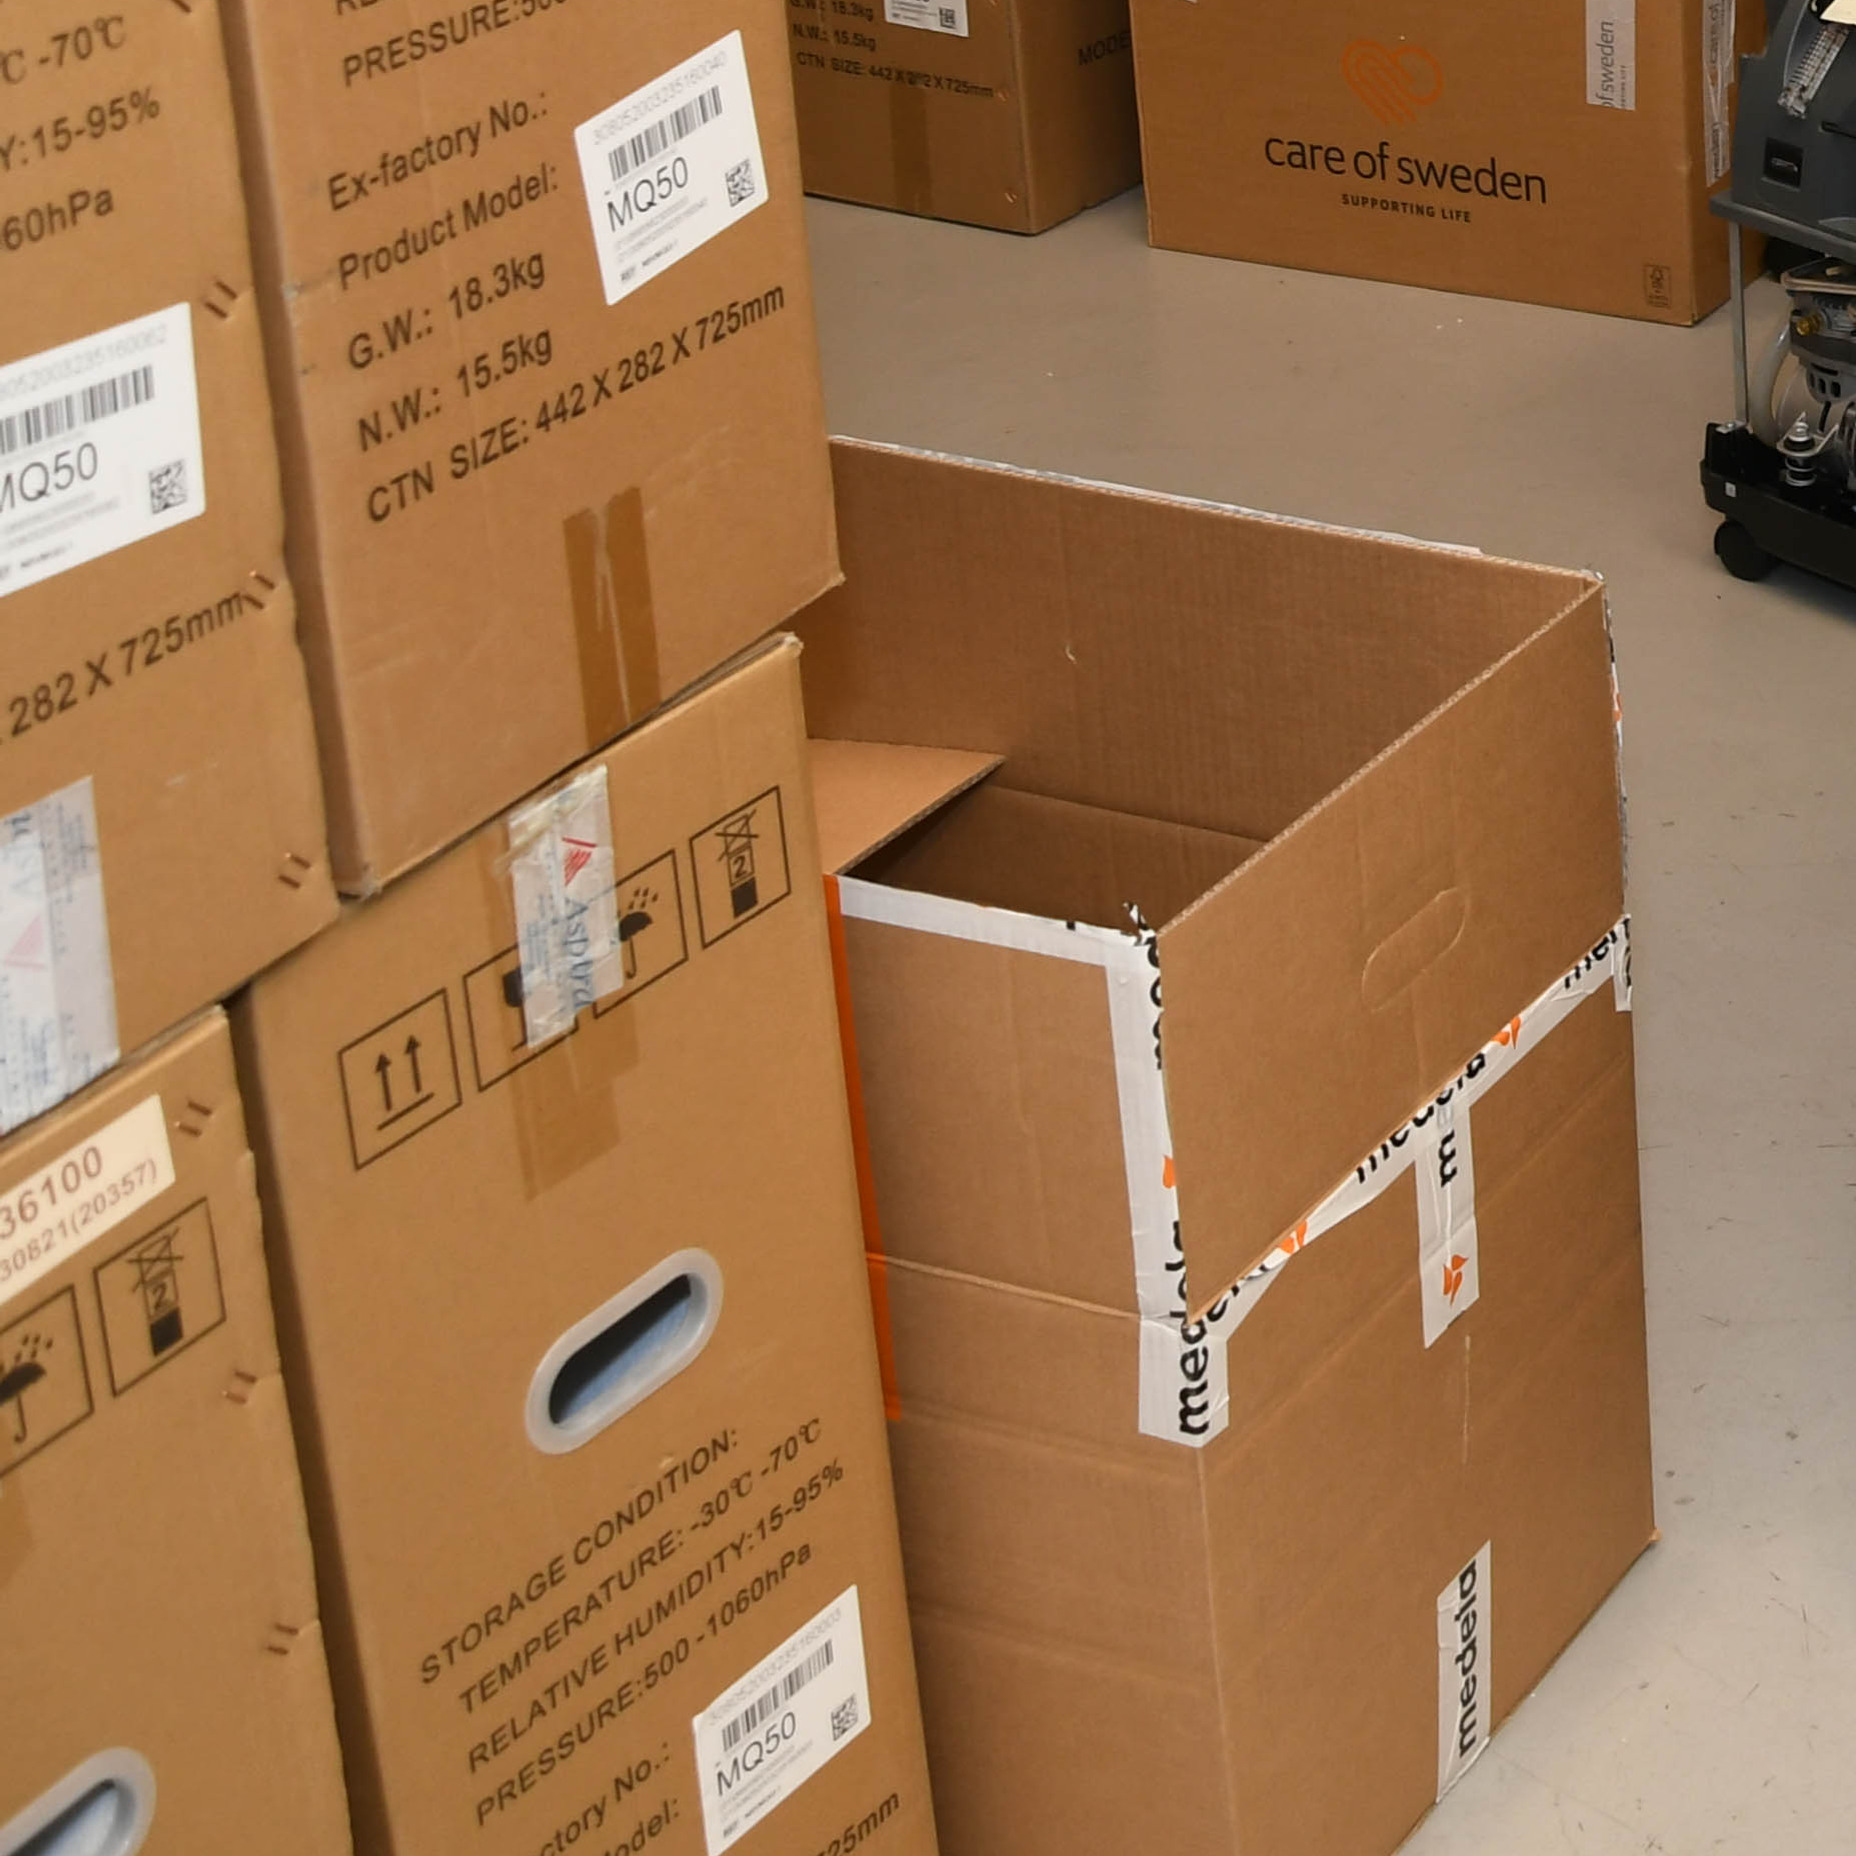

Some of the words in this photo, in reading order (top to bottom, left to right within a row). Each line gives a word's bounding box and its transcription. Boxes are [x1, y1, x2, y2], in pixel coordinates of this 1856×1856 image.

[796, 51, 826, 71] CTN
[830, 56, 866, 76] SIZE:
[868, 64, 894, 82] 442
[945, 76, 994, 98] 725mm
[1594, 20, 1615, 92] sweden
[328, 122, 482, 213] Ex-factory
[488, 91, 549, 129] No.:
[606, 155, 690, 233] MQ50
[1263, 132, 1349, 174] care
[1352, 139, 1391, 178] of
[1396, 155, 1549, 206] sweden
[1341, 192, 1436, 220] SUPPORTING
[1440, 206, 1473, 224] LIFE
[337, 204, 457, 290] Product
[461, 165, 558, 229] Model:
[348, 304, 433, 370] G.W.:
[447, 252, 546, 322] 18.3kg
[357, 386, 442, 452] N.W.:
[456, 328, 553, 399] 15.5kg
[366, 462, 436, 524] CTN
[449, 415, 529, 480] SIZE:
[535, 383, 588, 434] 442
[591, 368, 613, 401] X
[616, 341, 667, 394] 282
[669, 326, 692, 360] X
[693, 283, 786, 352] 725mm
[8, 672, 78, 739] 282
[85, 651, 114, 697] X
[118, 590, 244, 677] 725mm
[421, 1555, 568, 1685] STORAGE
[573, 1428, 739, 1565] CONDITION:
[457, 1525, 684, 1716] TEMPERATURE:
[1457, 1559, 1479, 1758] medela
[467, 1638, 610, 1776] RELATIVE
[474, 1636, 692, 1828] PRESSURE:500
[695, 1540, 813, 1646] -1060hPa
[613, 1742, 672, 1805] No.:
[714, 1709, 799, 1798] MQ50
